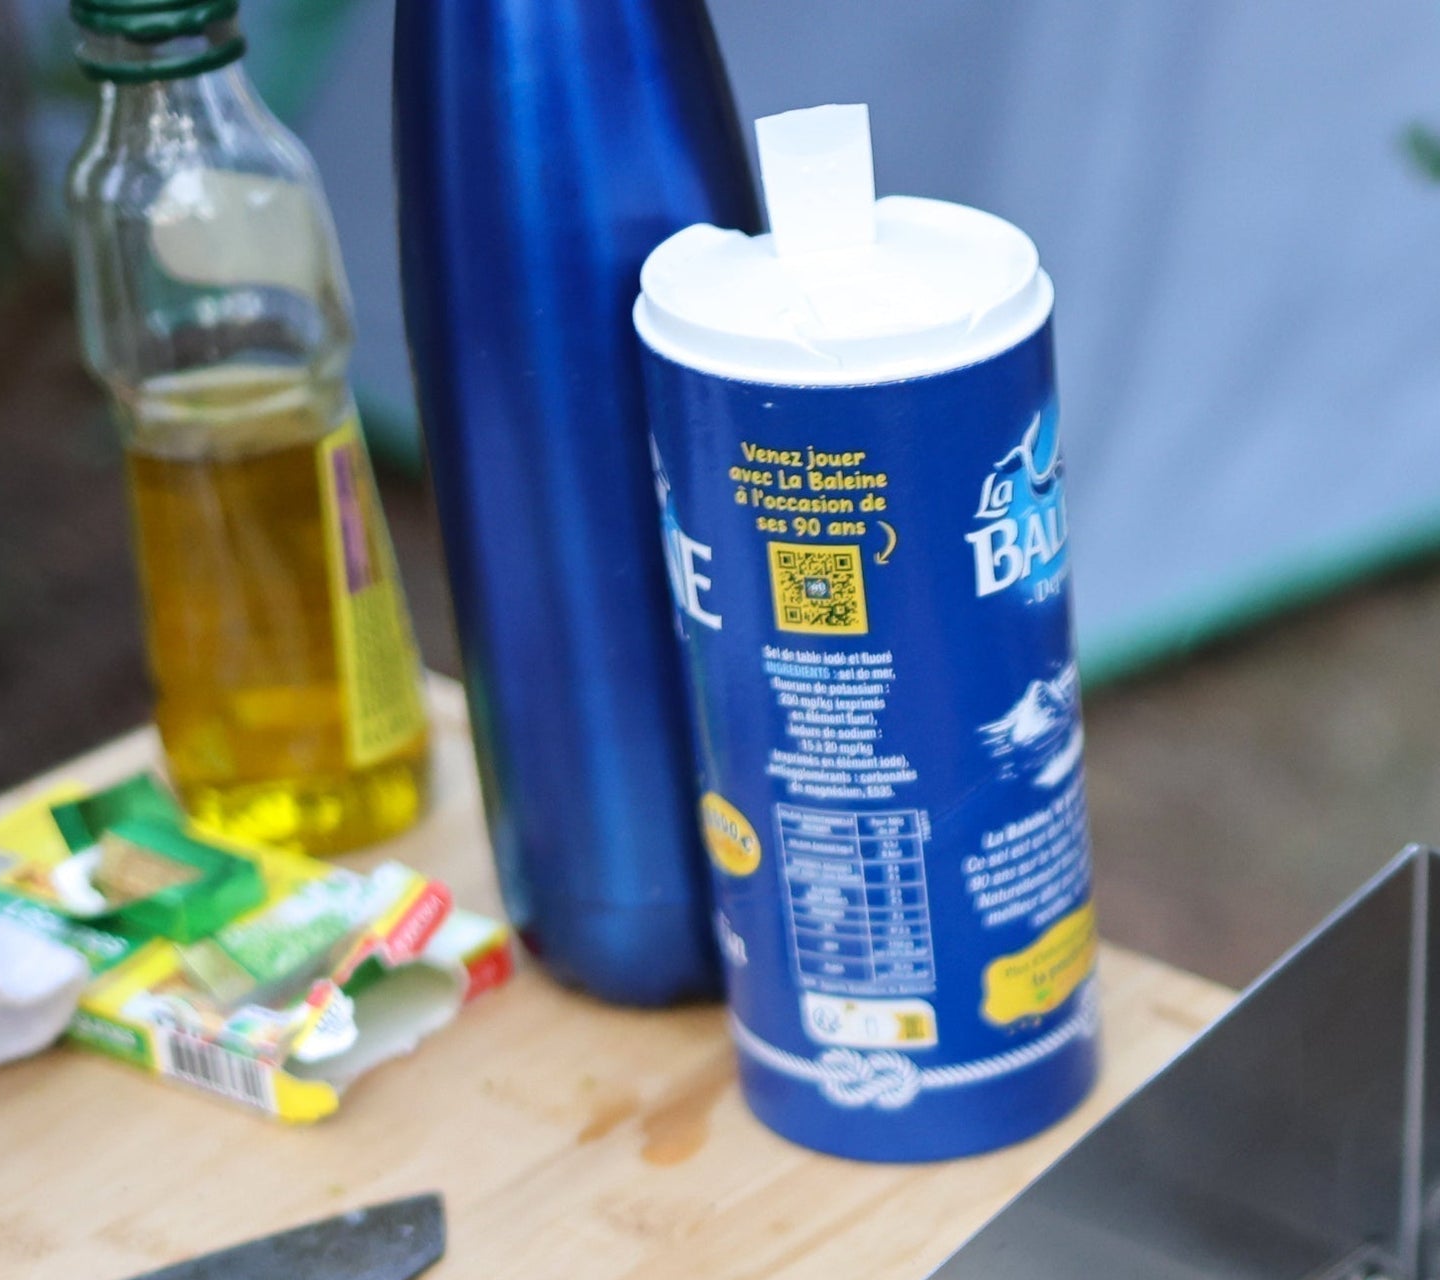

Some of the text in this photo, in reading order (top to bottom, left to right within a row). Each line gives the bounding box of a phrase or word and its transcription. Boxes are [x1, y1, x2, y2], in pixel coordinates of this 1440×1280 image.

[741, 441, 866, 471] Venez jouer
[729, 466, 888, 491] avec La Baleine
[751, 488, 854, 513] l'occasion
[860, 493, 887, 513] de
[973, 472, 1013, 518] La
[756, 516, 866, 537] ses 90 ans
[781, 647, 795, 661] de
[795, 650, 822, 664] table
[848, 653, 860, 664] et
